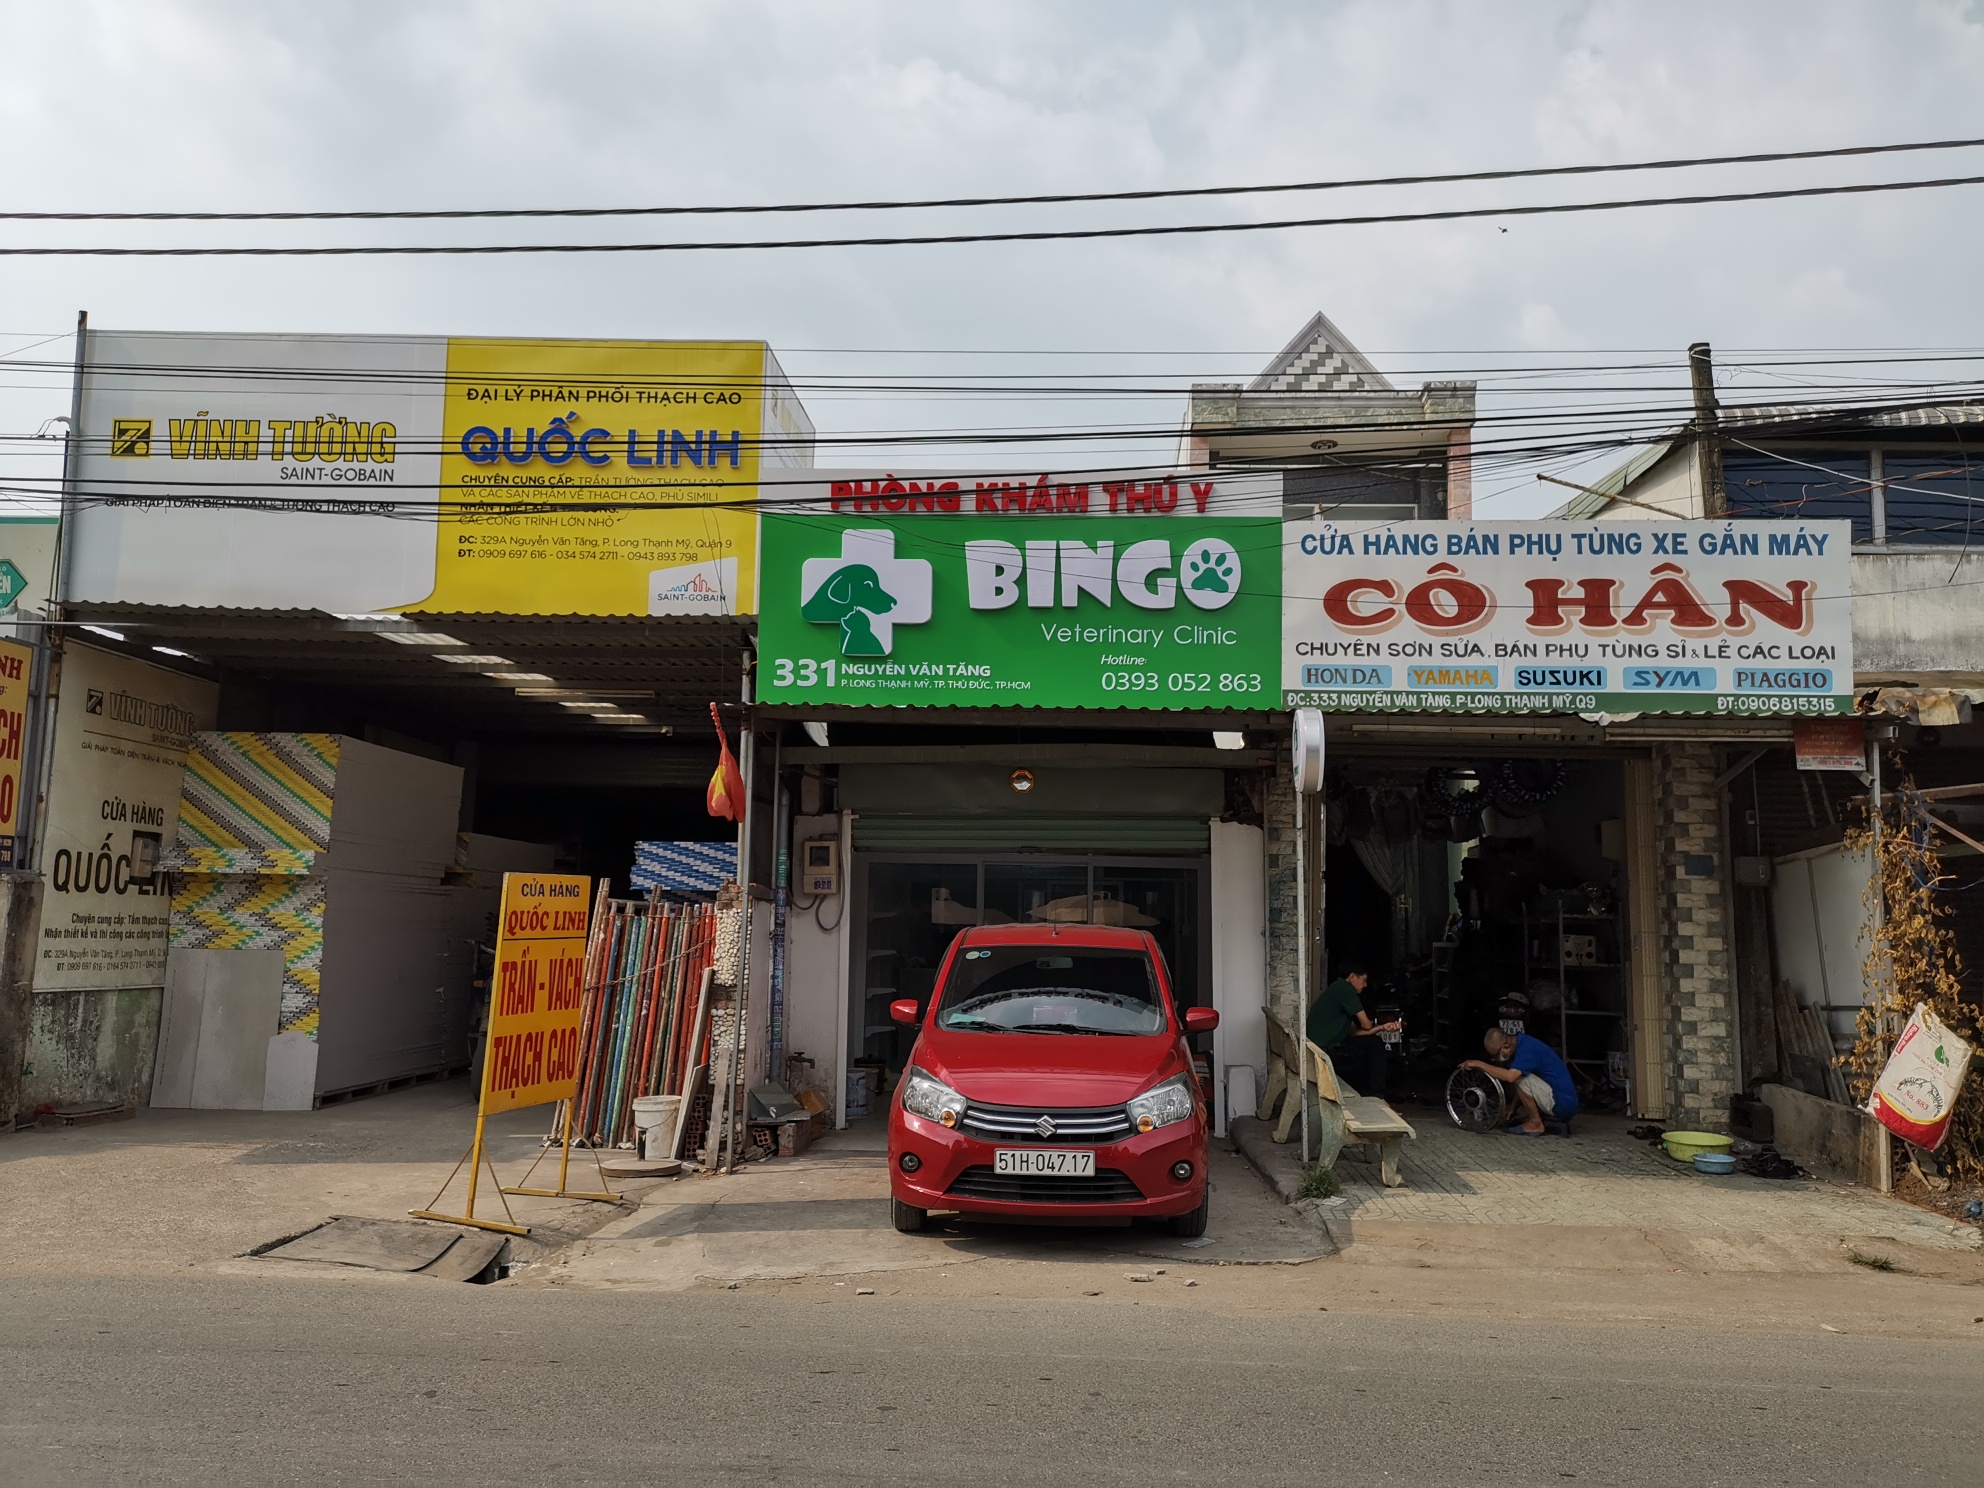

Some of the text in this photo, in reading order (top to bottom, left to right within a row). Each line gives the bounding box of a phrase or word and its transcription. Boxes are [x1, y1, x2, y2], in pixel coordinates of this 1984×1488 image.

[466, 384, 742, 407] ĐẠI LÝ PHÂN PHỐI THẠCH CAO
[168, 410, 397, 464] VĨNH TƯỜNG
[460, 410, 742, 468] QUỐC LINH
[279, 466, 395, 483] SAINT-GOBAIN
[461, 473, 509, 485] CHUYÊN
[512, 475, 546, 486] CUNG
[548, 472, 575, 486] CẤP:
[588, 490, 627, 502] THẠCH
[686, 491, 718, 501] SIMILI
[829, 473, 962, 513] PHÒNG
[974, 474, 1090, 513] KHÁM
[1190, 481, 1215, 513] Y
[524, 514, 558, 527] TRÌNH
[560, 514, 585, 528] LỚN
[588, 514, 615, 528] NHỎ
[458, 535, 478, 545] ĐC:
[480, 535, 507, 545] 329A
[509, 534, 549, 548] Nguyễn
[551, 537, 571, 547] Văn
[573, 536, 600, 548] Tăng,
[602, 538, 611, 547] P.
[613, 538, 640, 549] Long
[641, 538, 673, 550] Thạnh
[675, 538, 694, 550] Mỹ,
[725, 539, 732, 549] 9
[1300, 523, 1830, 562] CỬA HÀNG BÁN PHỤ TÙNG XE GẮN MÁY
[457, 548, 698, 562] ĐT: 0909 697 616 034 574 2711 0943 893 798
[964, 536, 1243, 611] BINGO
[657, 593, 726, 602] SAINT-GOBAIN
[1323, 561, 1815, 637] CÔ HÂN
[1040, 621, 1239, 649] Veterinary Clinic
[1101, 653, 1148, 666] Hotline:
[1295, 638, 1381, 658] CHUYÊN
[1387, 641, 1433, 658] SƠN
[1494, 641, 1538, 659] BÁN
[1545, 643, 1589, 664] PHỤ
[1597, 640, 1660, 659] TÙNG
[1666, 640, 1687, 659] SỈ
[1703, 640, 1731, 660] LẺ
[1737, 642, 1781, 660] CÁC
[1787, 645, 1837, 664] LOẠI
[772, 658, 836, 688] 331
[841, 658, 991, 677] NGUYỄN VĂN TĂNG
[1306, 668, 1384, 686] HONDA
[877, 679, 911, 690] THẠNH
[914, 678, 933, 690] MỸ,
[933, 680, 946, 689] TP.
[947, 679, 968, 690] THỦ
[968, 678, 993, 691] ĐỨC,
[994, 681, 1032, 690] TP.HCM
[1101, 672, 1262, 694] 0393 052 863
[1412, 669, 1494, 686] YAMAHA
[1518, 669, 1603, 687] SUZUKI
[1633, 670, 1701, 688] SYM
[1736, 671, 1828, 690] PIAGGIO
[1341, 690, 1391, 707] NGUYỄN
[1503, 694, 1548, 710] THẠNH
[1717, 696, 1835, 711] ĐT:0906815315
[101, 796, 164, 827] CỬA HÀNG
[53, 832, 131, 897] QUỐC
[521, 877, 580, 898] CỬA HÀNG
[71, 912, 158, 926] Chuyên cung cấp: Tấm thạch
[506, 902, 587, 936] QUỐC LINH
[44, 928, 63, 941] Nhận
[64, 926, 80, 939] thiết
[80, 926, 89, 939] kế
[90, 928, 98, 939] và
[99, 928, 108, 939] thi
[109, 927, 123, 941] công
[124, 929, 135, 939] các
[136, 929, 151, 941] công
[67, 962, 80, 971] 0909
[499, 945, 539, 1017] TRẦN
[546, 948, 584, 1012] VÁCH
[491, 1026, 578, 1100] THẠCH CAO
[998, 1152, 1091, 1173] 51H-047.17
